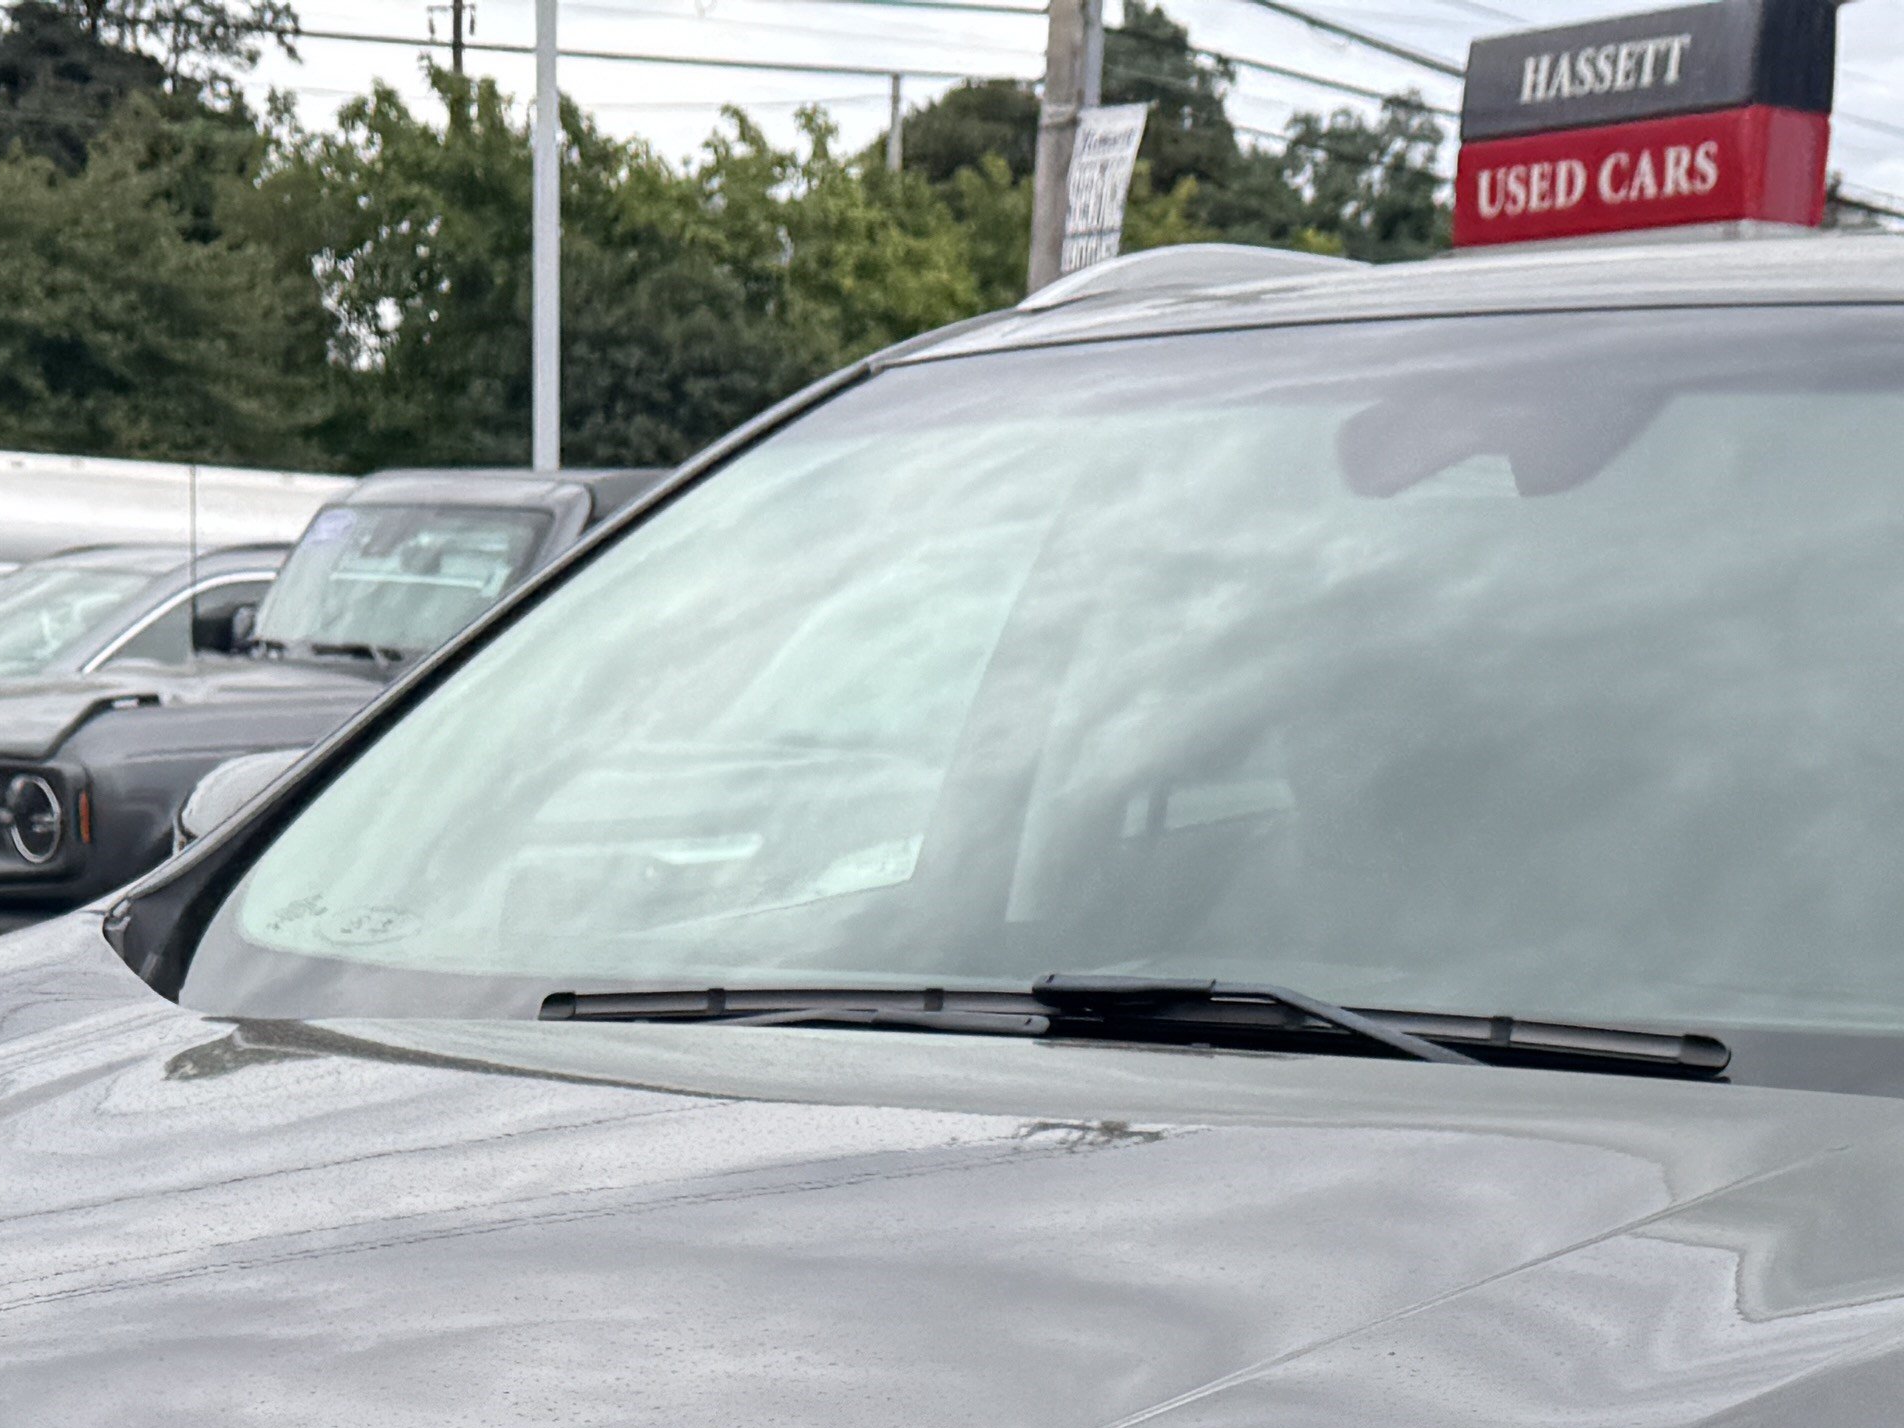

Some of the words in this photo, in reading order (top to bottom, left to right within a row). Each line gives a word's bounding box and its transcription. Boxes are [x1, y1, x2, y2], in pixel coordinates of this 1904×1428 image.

[1520, 33, 1692, 105] HASSETT
[1477, 158, 1588, 220] USED
[1598, 140, 1719, 205] CARS
